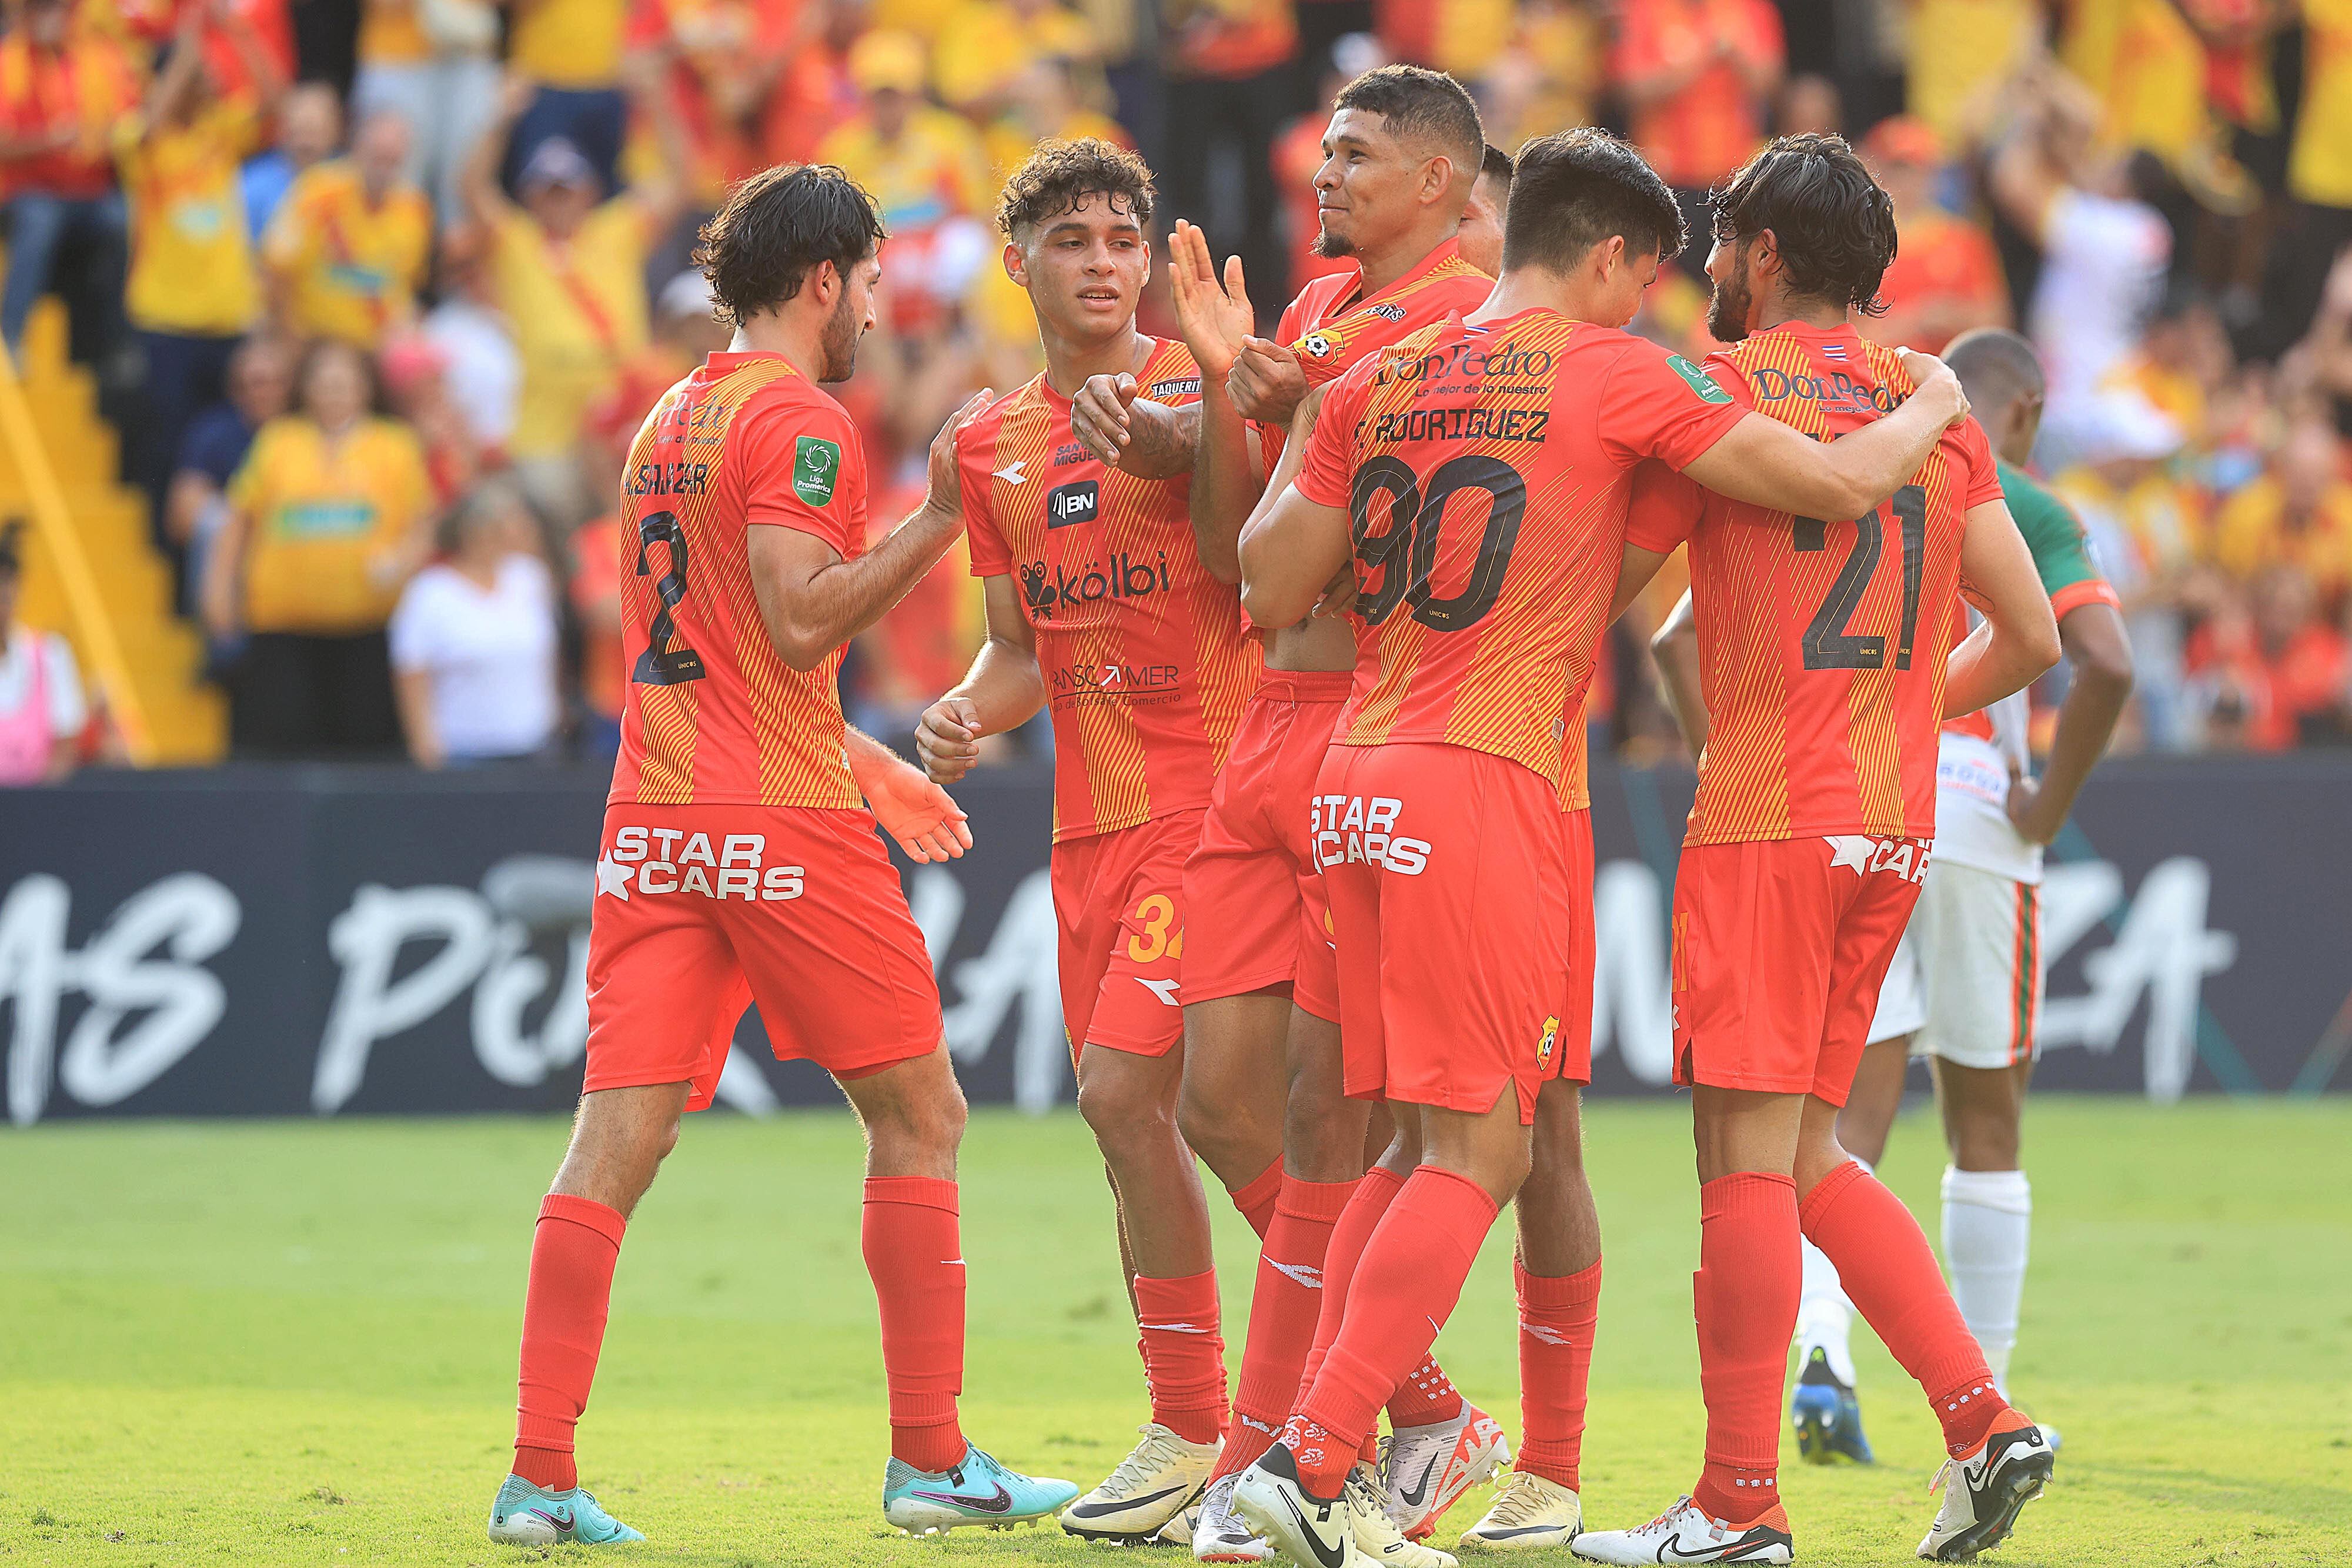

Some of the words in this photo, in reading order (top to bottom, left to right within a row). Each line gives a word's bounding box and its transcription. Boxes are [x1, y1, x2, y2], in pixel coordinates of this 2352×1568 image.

[1152, 380, 1200, 396] TAQUERIT
[1464, 383, 1479, 394] de
[1499, 385, 1548, 395] nuestro
[1375, 409, 1550, 443] RODRIGUEZ
[1057, 442, 1081, 456] SAN
[797, 480, 831, 493] Promerica
[809, 474, 823, 484] Liga
[1352, 454, 1526, 632] 90
[632, 510, 706, 686] 2
[1057, 550, 1170, 609] kölbi
[1793, 485, 1926, 671] 21
[1123, 693, 1181, 706] Comercio
[1311, 795, 1403, 834] STAR
[613, 826, 766, 868] STAR
[1318, 830, 1432, 875] CARS
[1870, 839, 1932, 887] CAR
[638, 860, 806, 901] CARS
